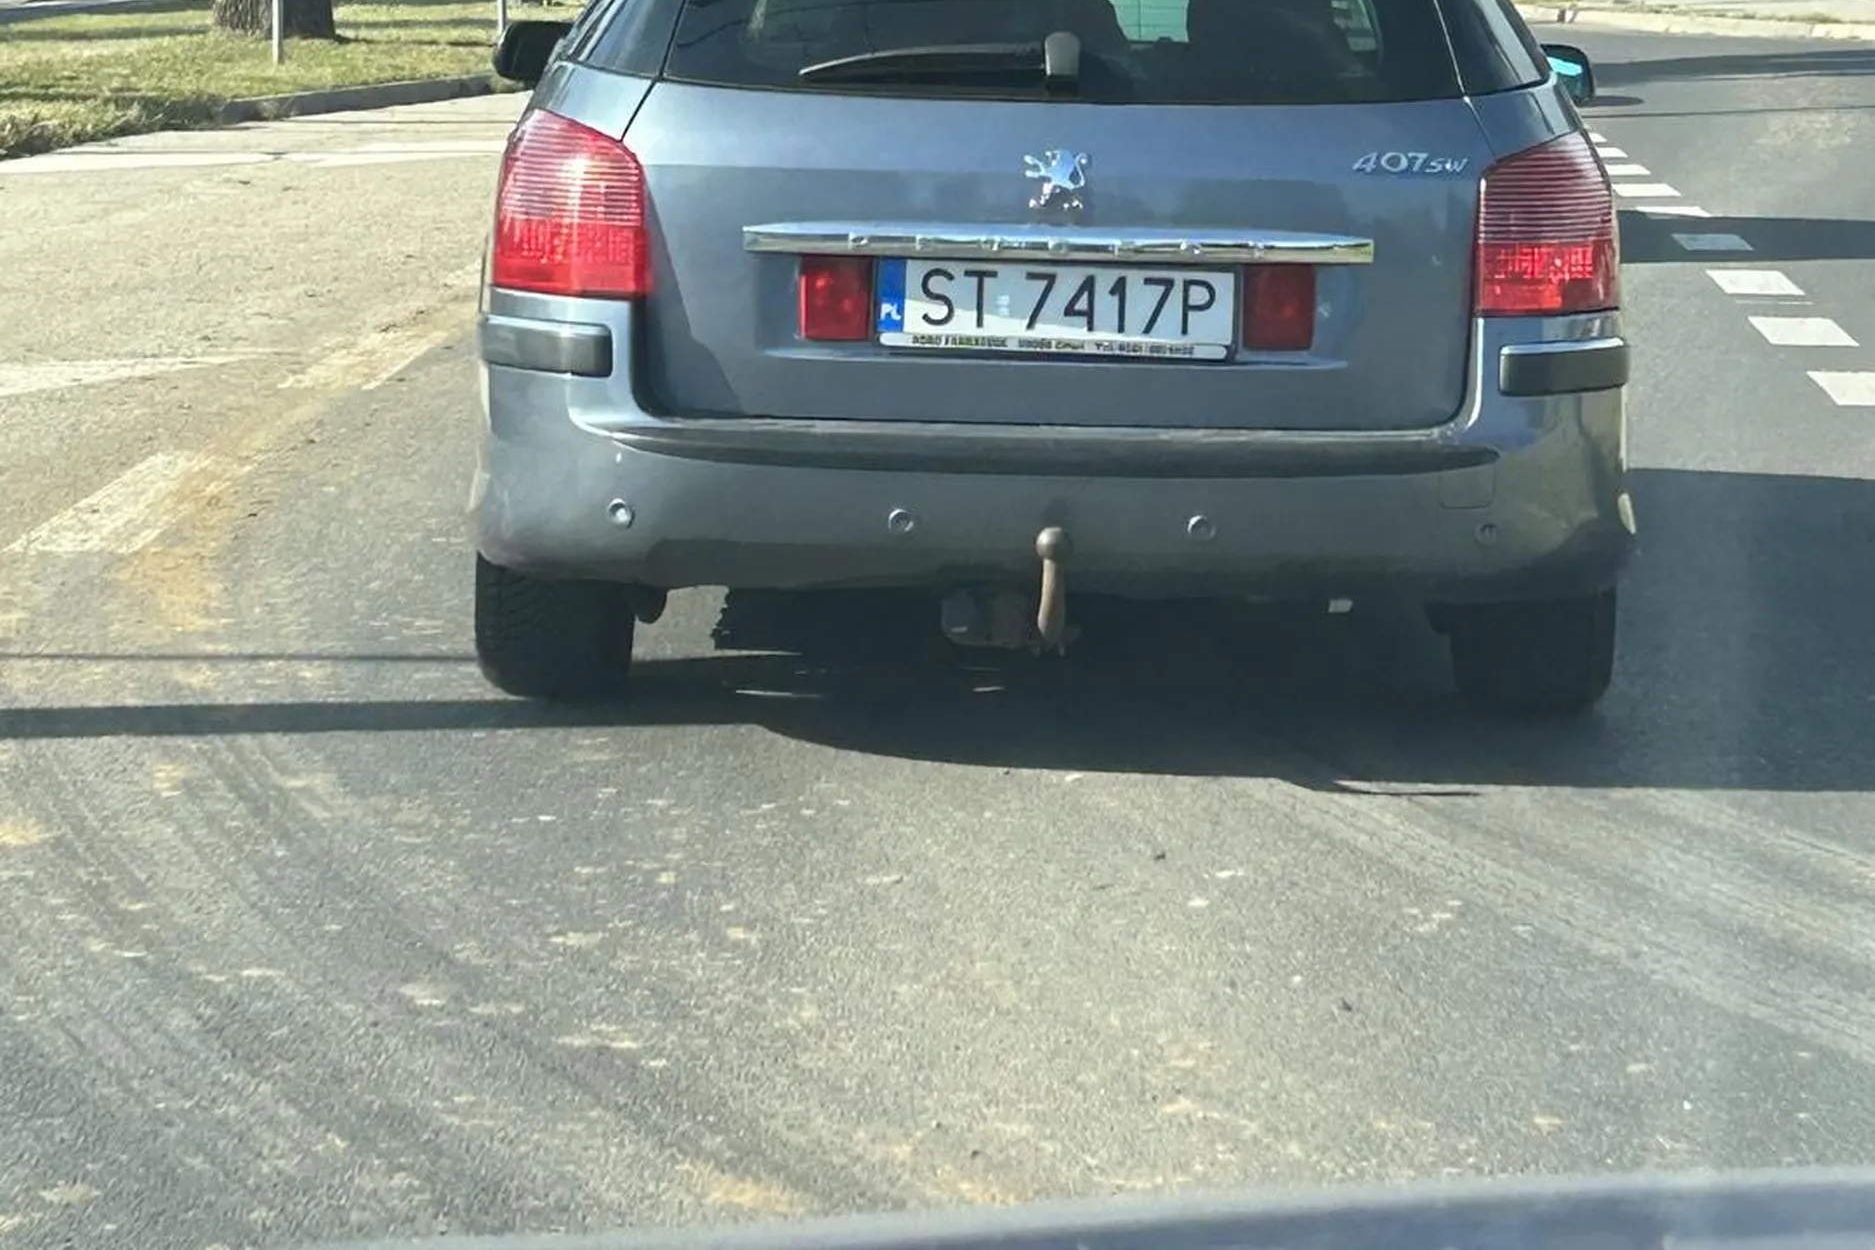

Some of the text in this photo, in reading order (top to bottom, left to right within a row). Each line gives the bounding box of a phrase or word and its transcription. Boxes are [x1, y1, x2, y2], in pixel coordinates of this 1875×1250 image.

[880, 302, 902, 320] PL
[921, 267, 1216, 336] ST 7417P
